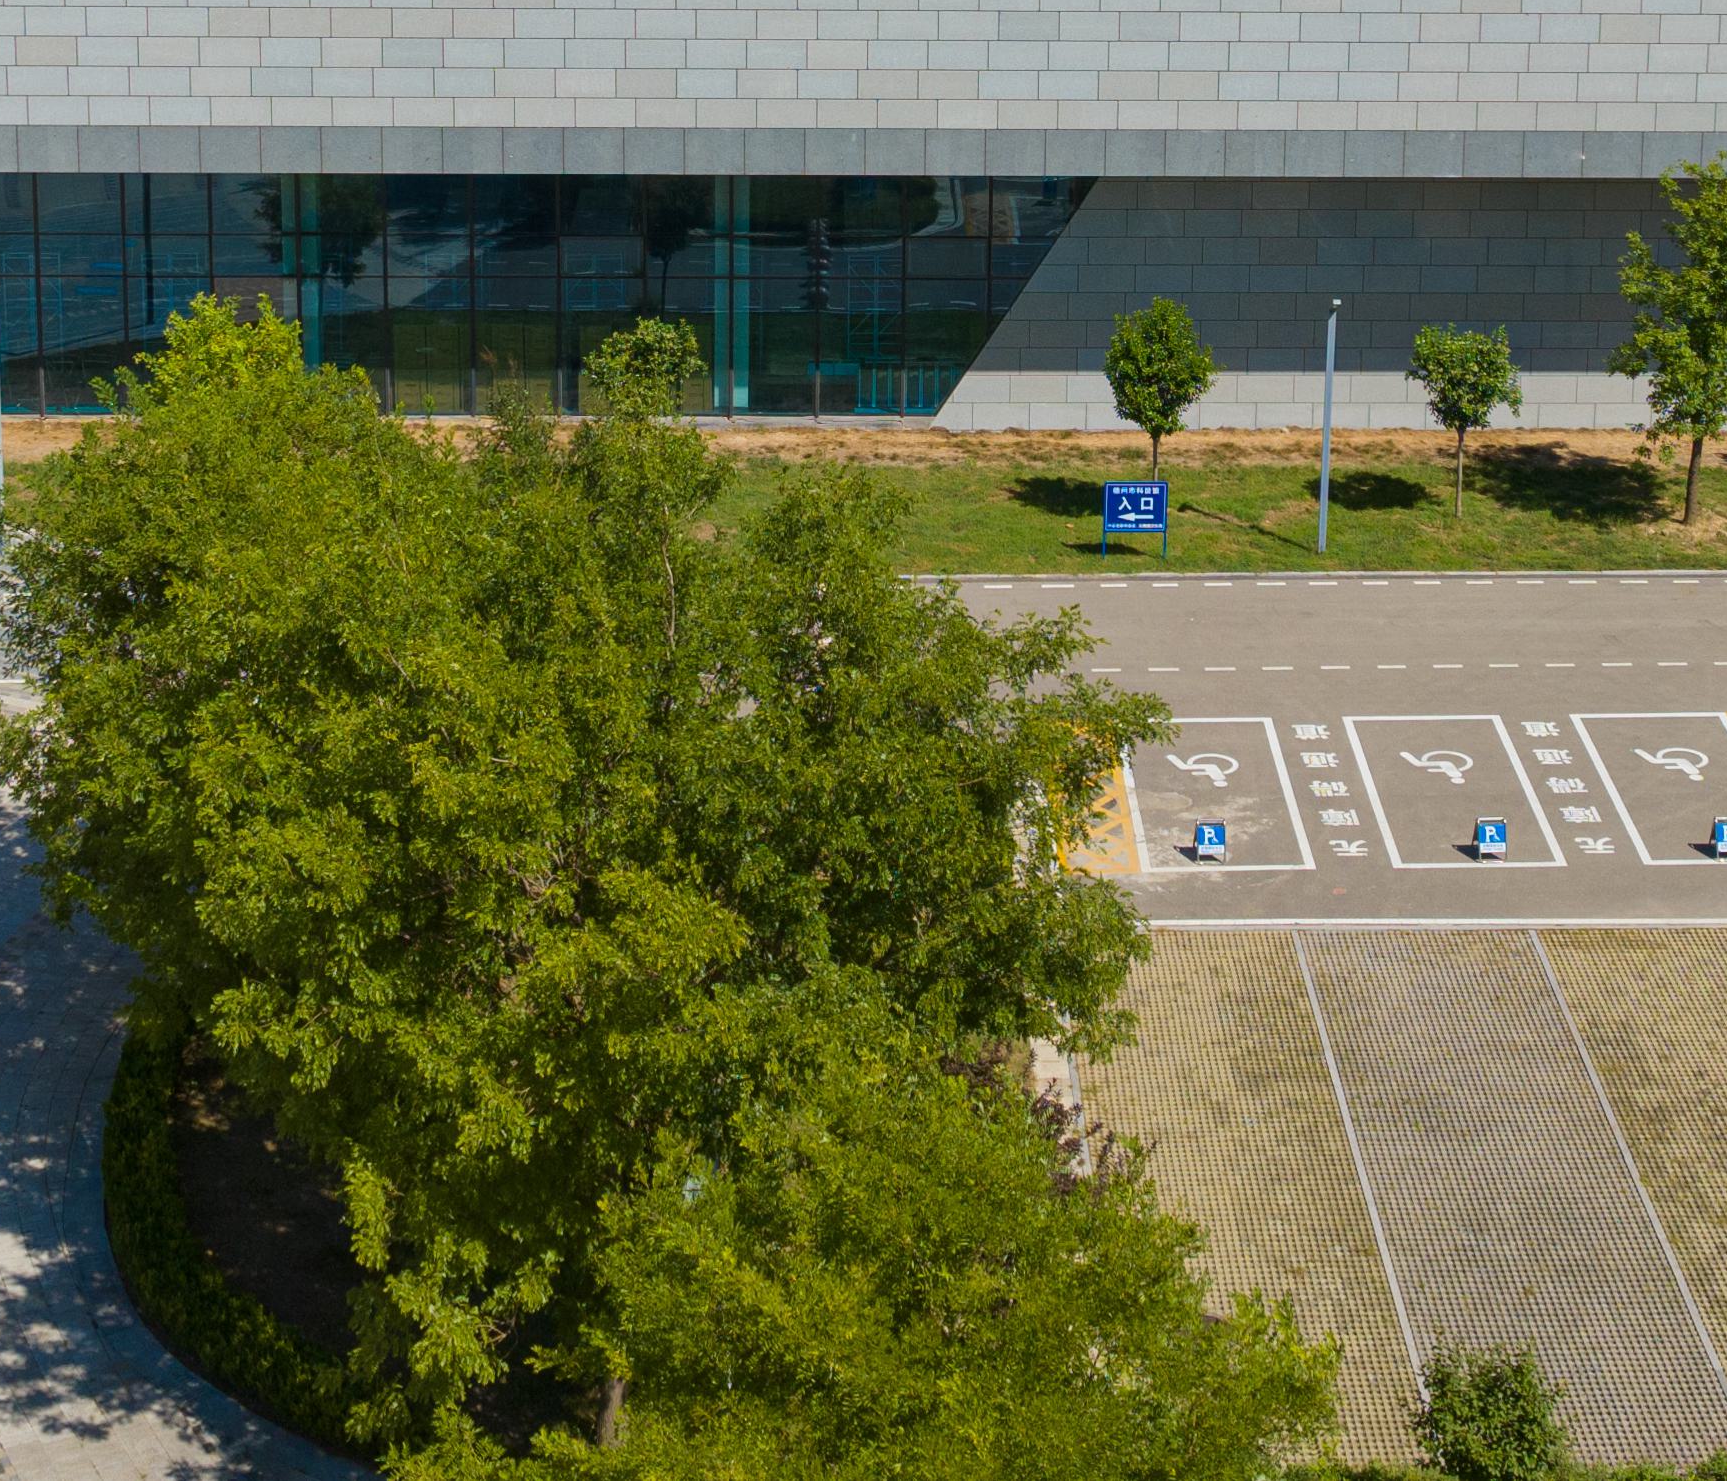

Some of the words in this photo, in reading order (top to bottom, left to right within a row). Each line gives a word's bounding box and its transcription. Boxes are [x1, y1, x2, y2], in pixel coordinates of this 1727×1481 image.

[1118, 496, 1154, 511] 入口
[1291, 724, 1369, 857] 无障碍通道
[1520, 721, 1616, 854] 无障碍通道
